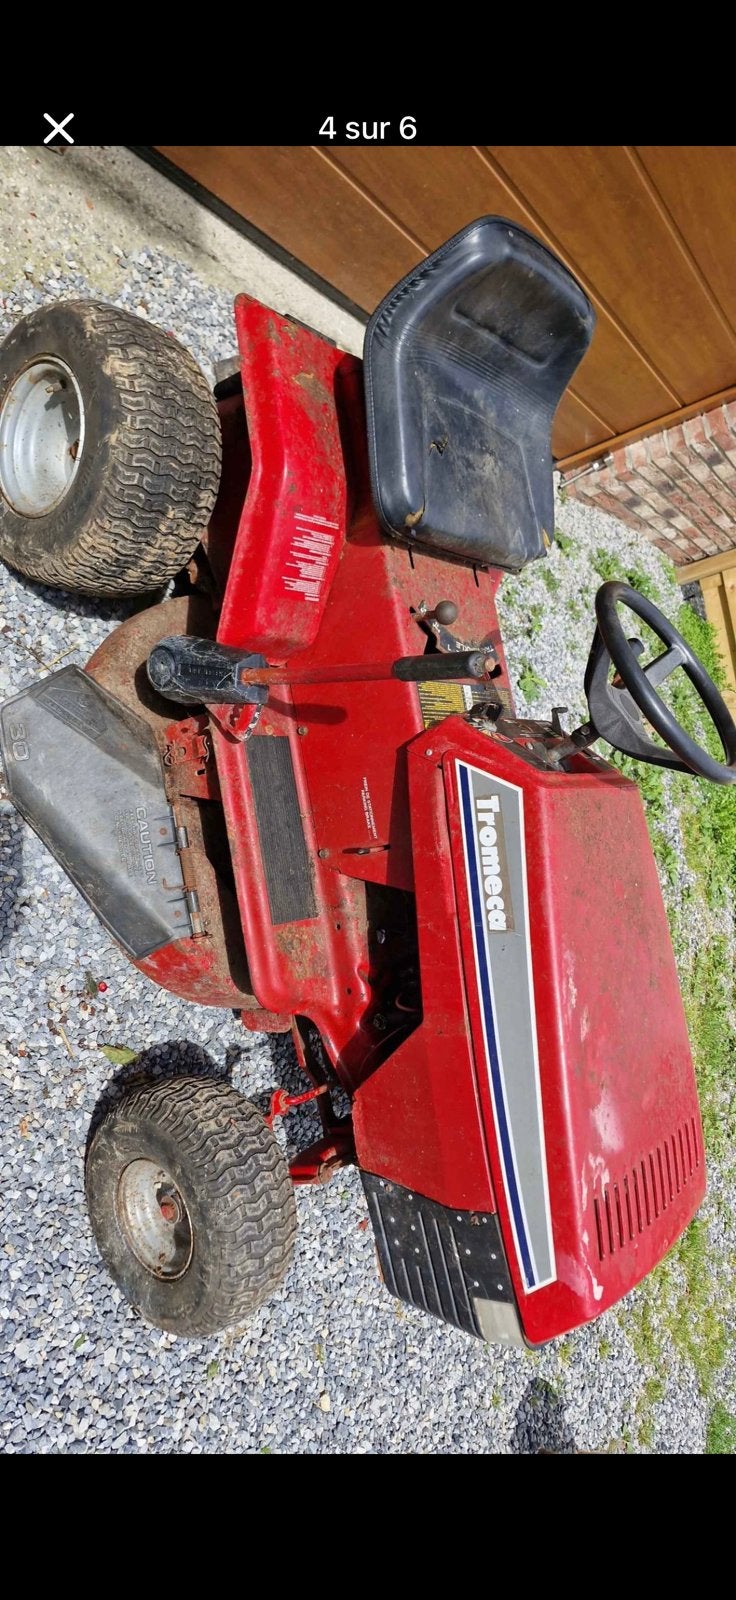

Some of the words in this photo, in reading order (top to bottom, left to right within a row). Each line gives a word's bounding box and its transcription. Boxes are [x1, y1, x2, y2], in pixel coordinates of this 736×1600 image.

[9, 723, 30, 761] 30
[135, 807, 157, 885] CAUTION
[476, 795, 507, 931] Tromeca
